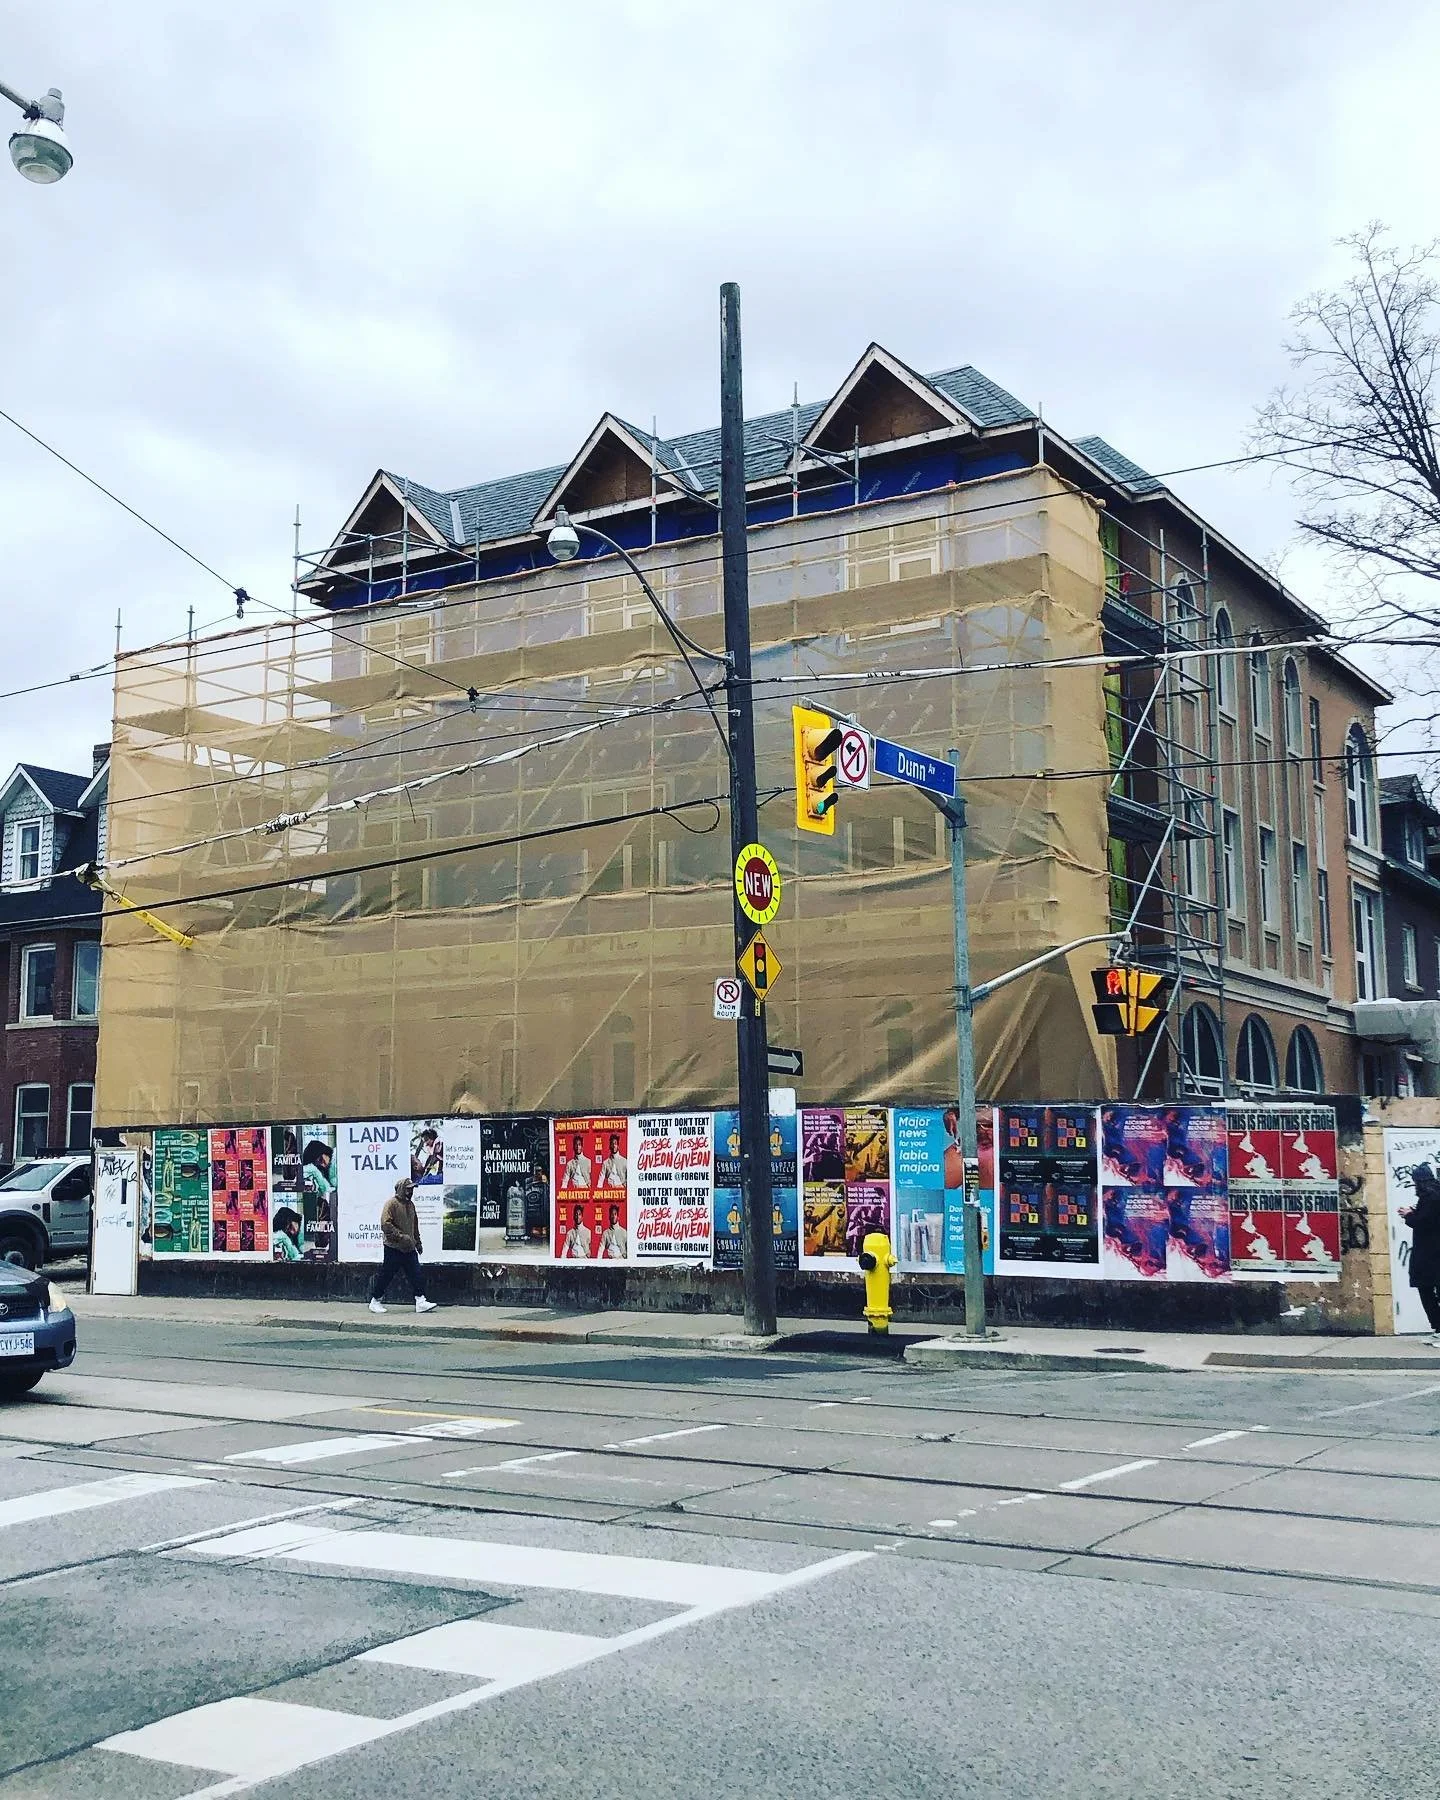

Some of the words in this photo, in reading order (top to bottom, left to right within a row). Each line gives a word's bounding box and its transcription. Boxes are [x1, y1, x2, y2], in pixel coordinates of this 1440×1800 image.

[897, 751, 926, 781] Dunn
[927, 763, 936, 775] Av
[744, 871, 771, 898] NEW
[555, 1122, 567, 1131] JON
[566, 1120, 590, 1130] BATISTE
[592, 1120, 604, 1130] JON
[603, 1119, 627, 1129] BATISTE
[638, 1119, 657, 1128] DON'T
[658, 1118, 673, 1127] TEXT
[674, 1117, 693, 1126] DON'T
[694, 1117, 709, 1126] TEXT
[899, 1116, 930, 1129] Major
[1227, 1114, 1246, 1130] THIS
[1247, 1114, 1256, 1130] IS
[1257, 1114, 1280, 1130] FROM
[1280, 1114, 1300, 1130] THIS
[1301, 1114, 1310, 1130] IS
[1310, 1114, 1335, 1130] FROM
[349, 1126, 400, 1144] LAND
[642, 1128, 660, 1136] YOUR
[660, 1128, 669, 1136] EX
[678, 1127, 696, 1135] YOUR
[697, 1127, 705, 1135] EX
[899, 1130, 927, 1138] news
[367, 1144, 381, 1153] OF
[445, 1145, 457, 1153] let's
[457, 1145, 475, 1153] make
[639, 1137, 672, 1151] MESSAGE
[675, 1137, 708, 1151] MESSAGE
[910, 1140, 927, 1149] your
[456, 1153, 474, 1161] future
[483, 1149, 501, 1161] JACK
[501, 1149, 526, 1161] HONEY
[674, 1150, 711, 1170] GIVEON
[899, 1149, 929, 1160] labia
[273, 1156, 303, 1166] FAMILIA
[350, 1154, 399, 1171] TALK
[637, 1150, 673, 1171] GIVEON
[484, 1161, 492, 1174] &
[492, 1161, 531, 1173] LEMONADE
[899, 1161, 940, 1174] majora
[557, 1190, 568, 1200] JON
[568, 1190, 591, 1199] BATISTE
[592, 1190, 604, 1200] JON
[603, 1189, 626, 1199] BATISTE
[637, 1187, 656, 1197] DON'T
[657, 1187, 673, 1197] TEXT
[674, 1187, 692, 1196] DON'T
[693, 1187, 710, 1196] TEXT
[641, 1197, 660, 1205] YOUR
[660, 1197, 669, 1205] EX
[678, 1197, 696, 1205] YOUR
[697, 1197, 705, 1205] EX
[1229, 1194, 1248, 1210] THIS
[1249, 1194, 1258, 1210] IS
[1259, 1194, 1282, 1210] FROM
[1284, 1195, 1303, 1211] THIS
[1304, 1195, 1313, 1211] IS
[1314, 1195, 1338, 1212] FROM
[482, 1204, 495, 1212] MAKE
[495, 1204, 501, 1212] IT
[482, 1211, 501, 1220] COUNT
[639, 1207, 672, 1221] MESSAGE
[675, 1207, 708, 1221] MESSAGE
[306, 1223, 336, 1233] FAMILIA
[358, 1223, 382, 1232] CALMI
[636, 1220, 673, 1240] GIVEON
[673, 1220, 711, 1241] GIVEON
[347, 1232, 370, 1240] NIGHT
[20, 1338, 33, 1349] 546
